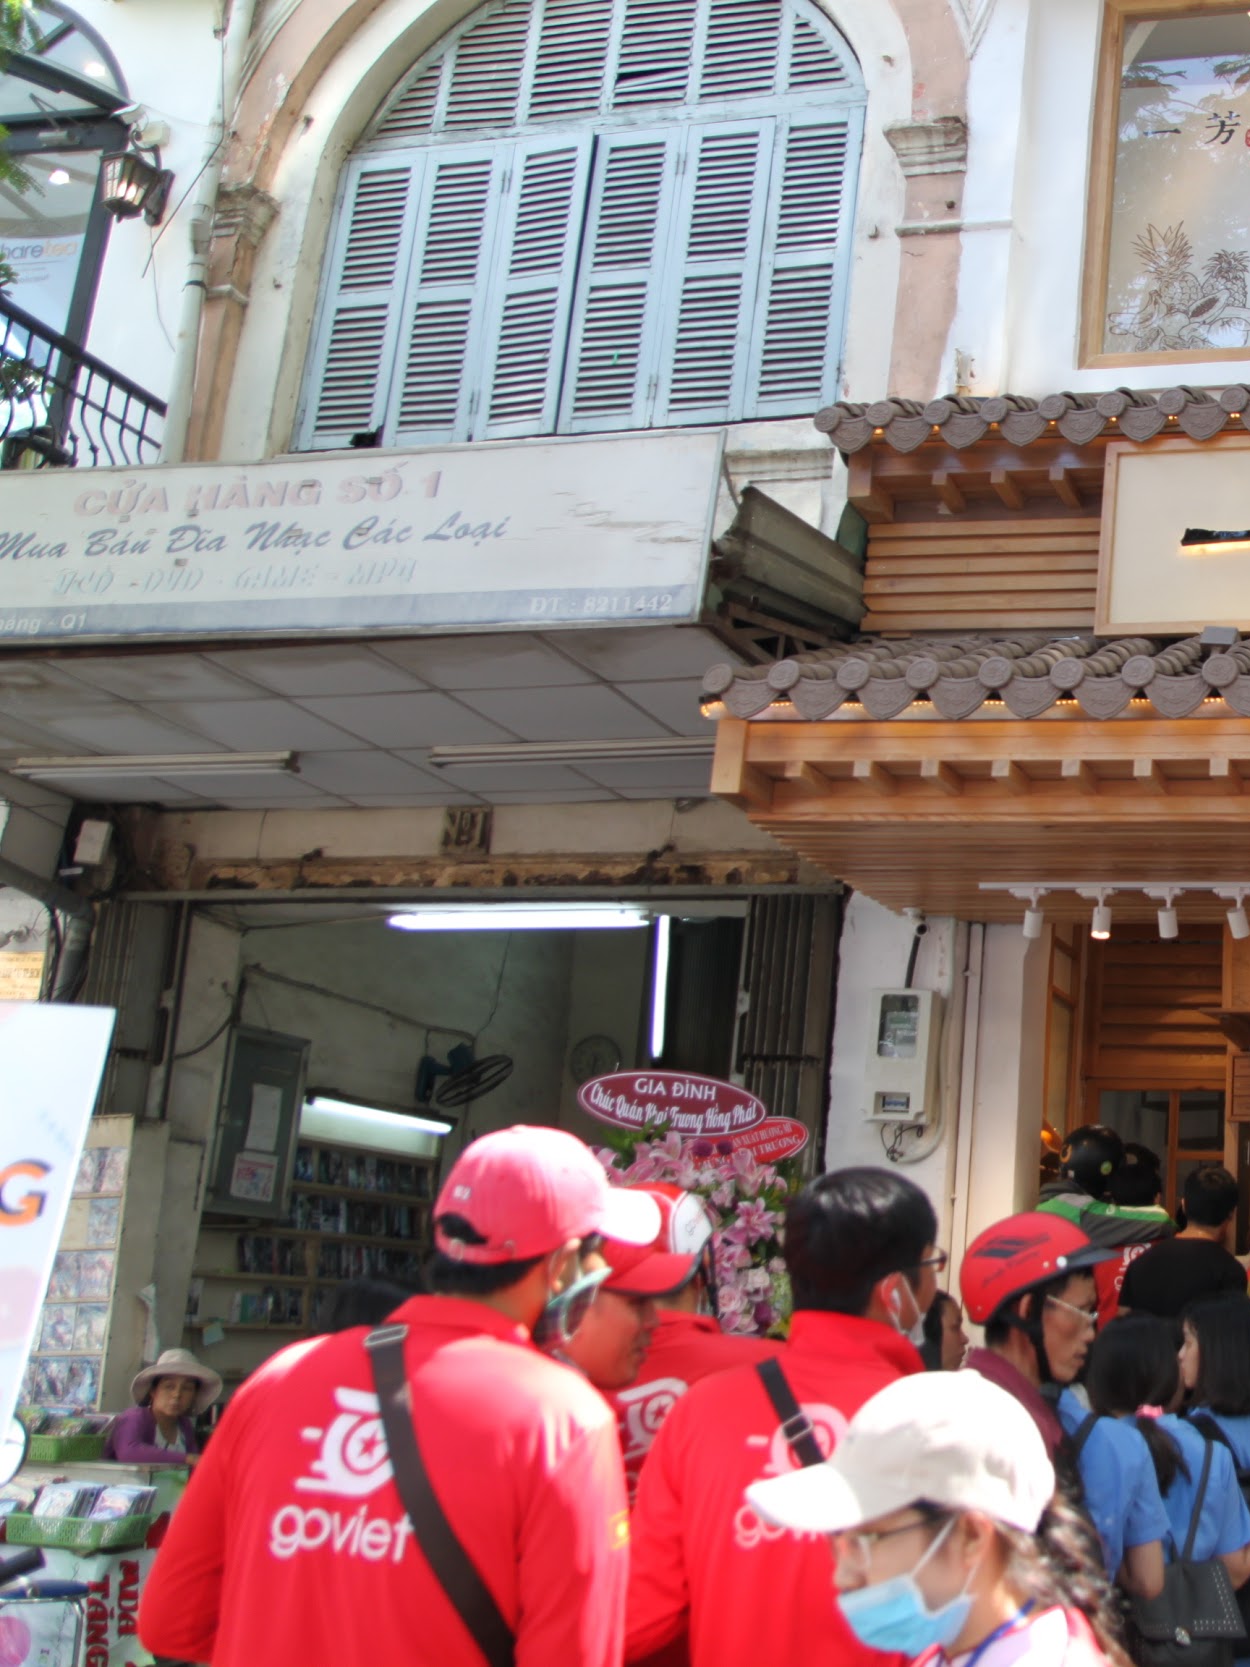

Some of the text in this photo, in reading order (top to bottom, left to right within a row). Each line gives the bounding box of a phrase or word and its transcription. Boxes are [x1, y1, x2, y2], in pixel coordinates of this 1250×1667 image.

[1143, 111, 1241, 144] 一芳
[422, 470, 443, 499] 1
[0, 511, 512, 561] Mua Bán Đĩa Nhạc Các Loại
[584, 594, 674, 614] 8211442
[60, 612, 87, 630] Q1
[590, 1083, 614, 1111] Chúc
[616, 1094, 643, 1120] Quán
[634, 1078, 716, 1100] GIA ĐÌNH
[269, 1503, 414, 1564] goviet
